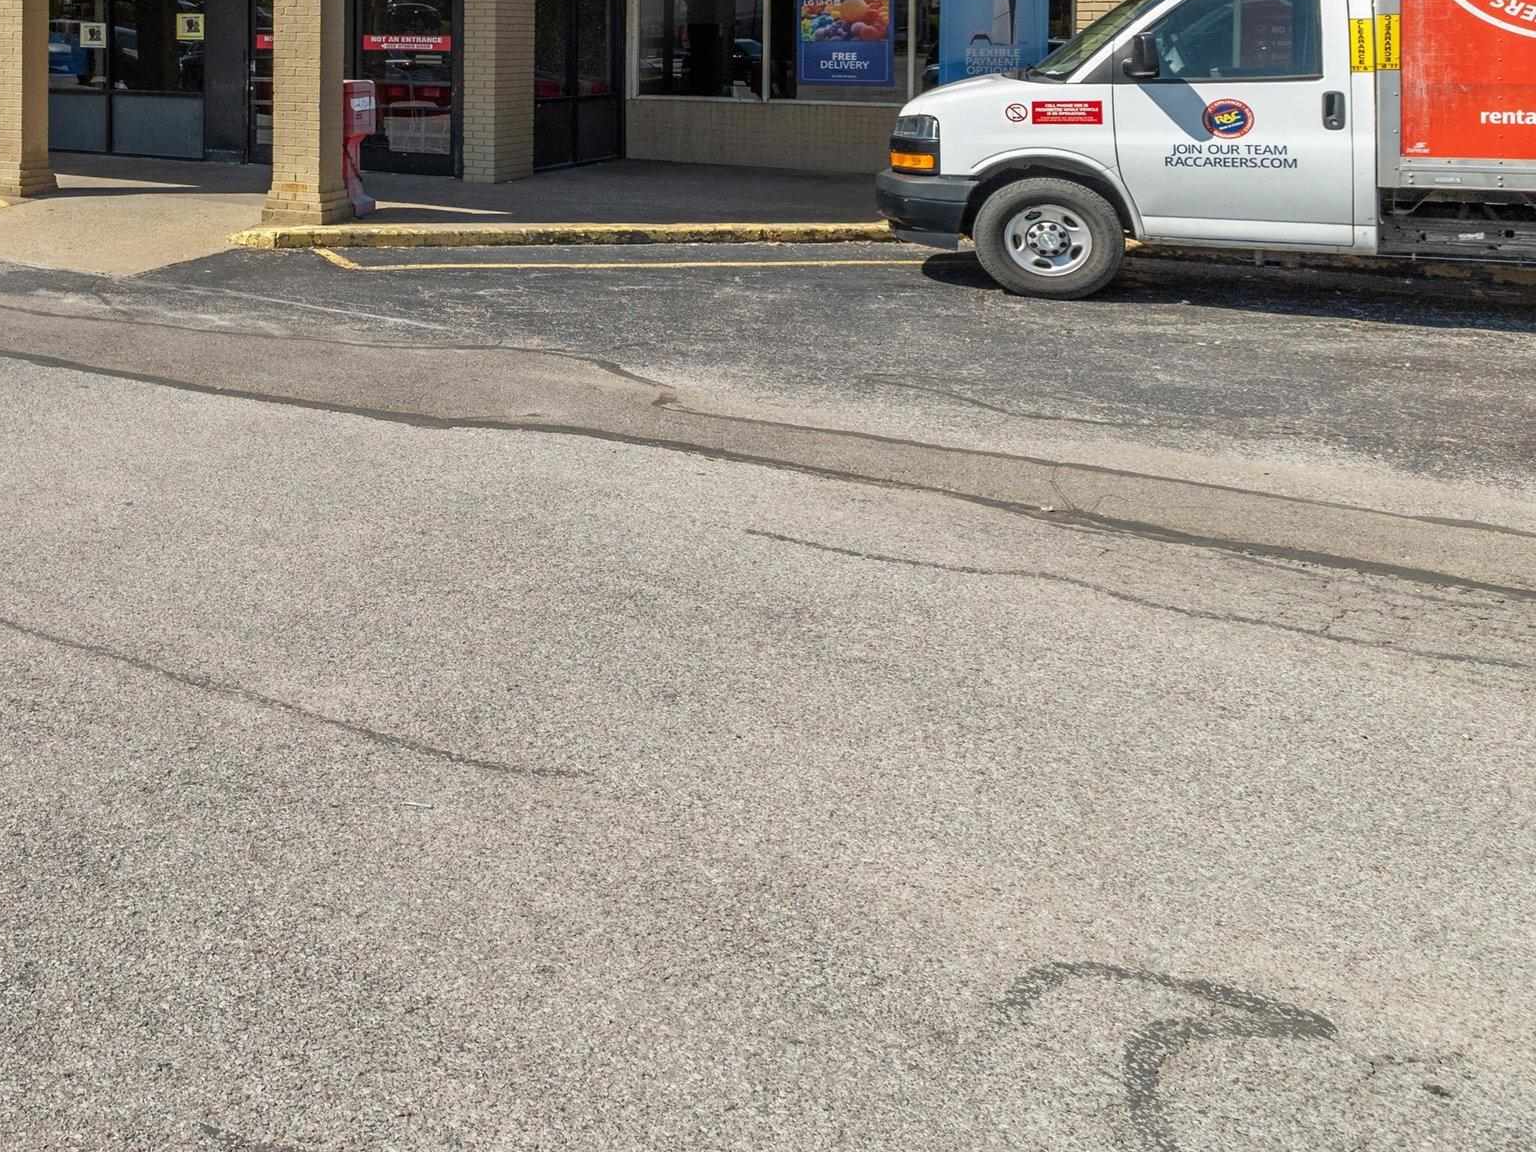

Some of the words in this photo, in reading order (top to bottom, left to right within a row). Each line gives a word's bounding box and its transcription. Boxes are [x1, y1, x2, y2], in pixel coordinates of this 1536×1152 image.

[401, 36, 443, 44] ENTRANCE
[831, 52, 857, 61] FREE
[966, 48, 1021, 57] FLEXIBLE
[820, 60, 870, 70] DELIVERY
[966, 57, 1020, 66] PAYMENT
[966, 65, 1016, 75] OPTION
[1171, 144, 1203, 156] JOIN
[1207, 144, 1240, 155] OUR
[1243, 144, 1288, 155] TEAM
[1164, 156, 1298, 169] RACCAREERS.COM
